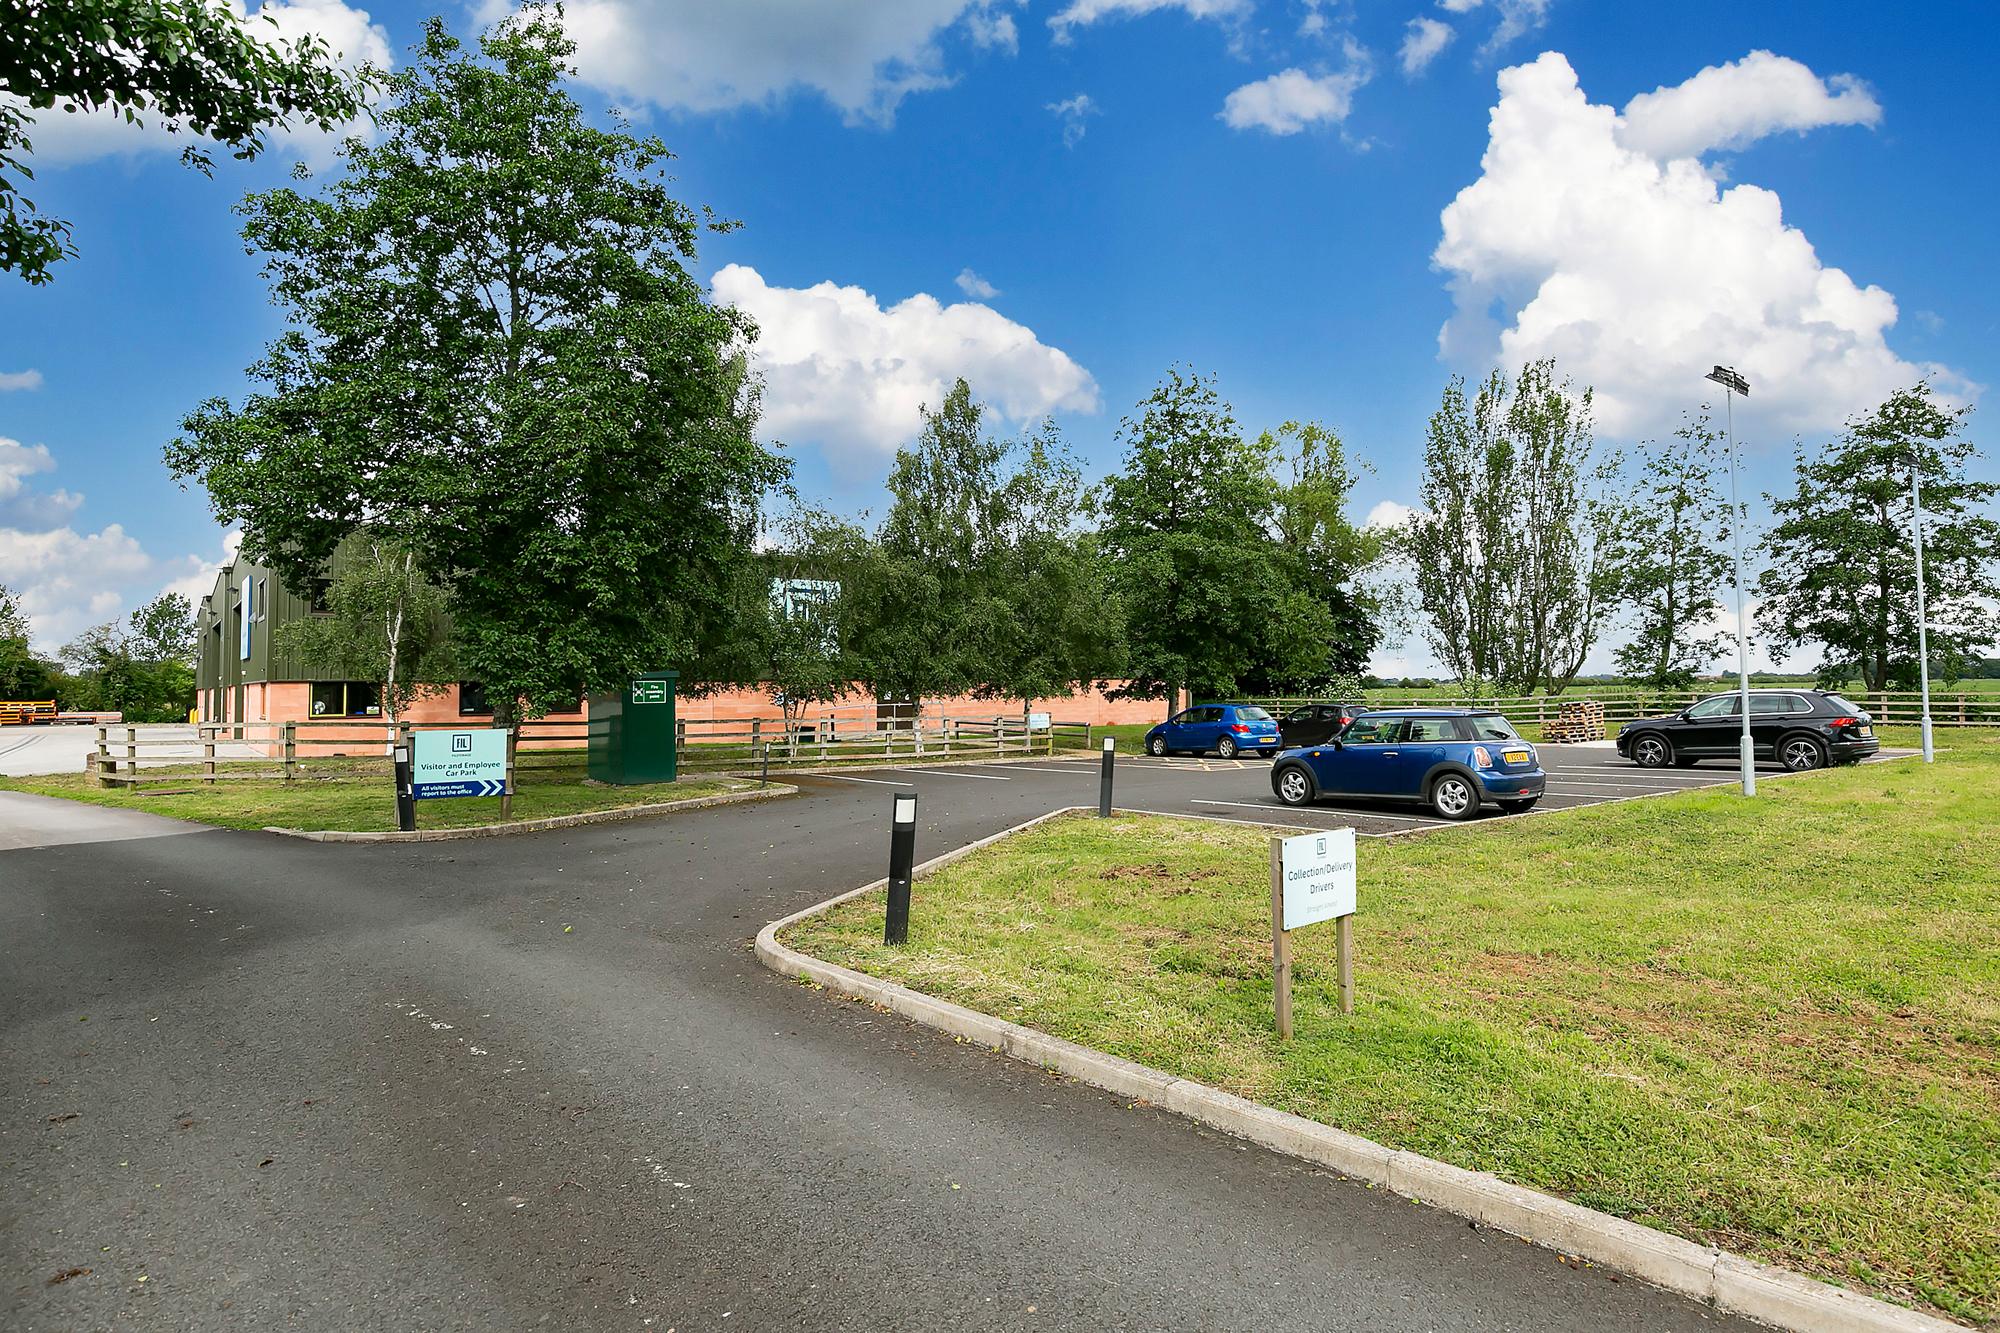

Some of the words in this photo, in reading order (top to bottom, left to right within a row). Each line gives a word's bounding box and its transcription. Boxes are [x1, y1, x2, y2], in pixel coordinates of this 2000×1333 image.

[457, 738, 467, 748] FIL
[464, 761, 501, 769] Employee
[1288, 861, 1353, 881] Collection/Delivery
[1310, 881, 1335, 894] Drivers
